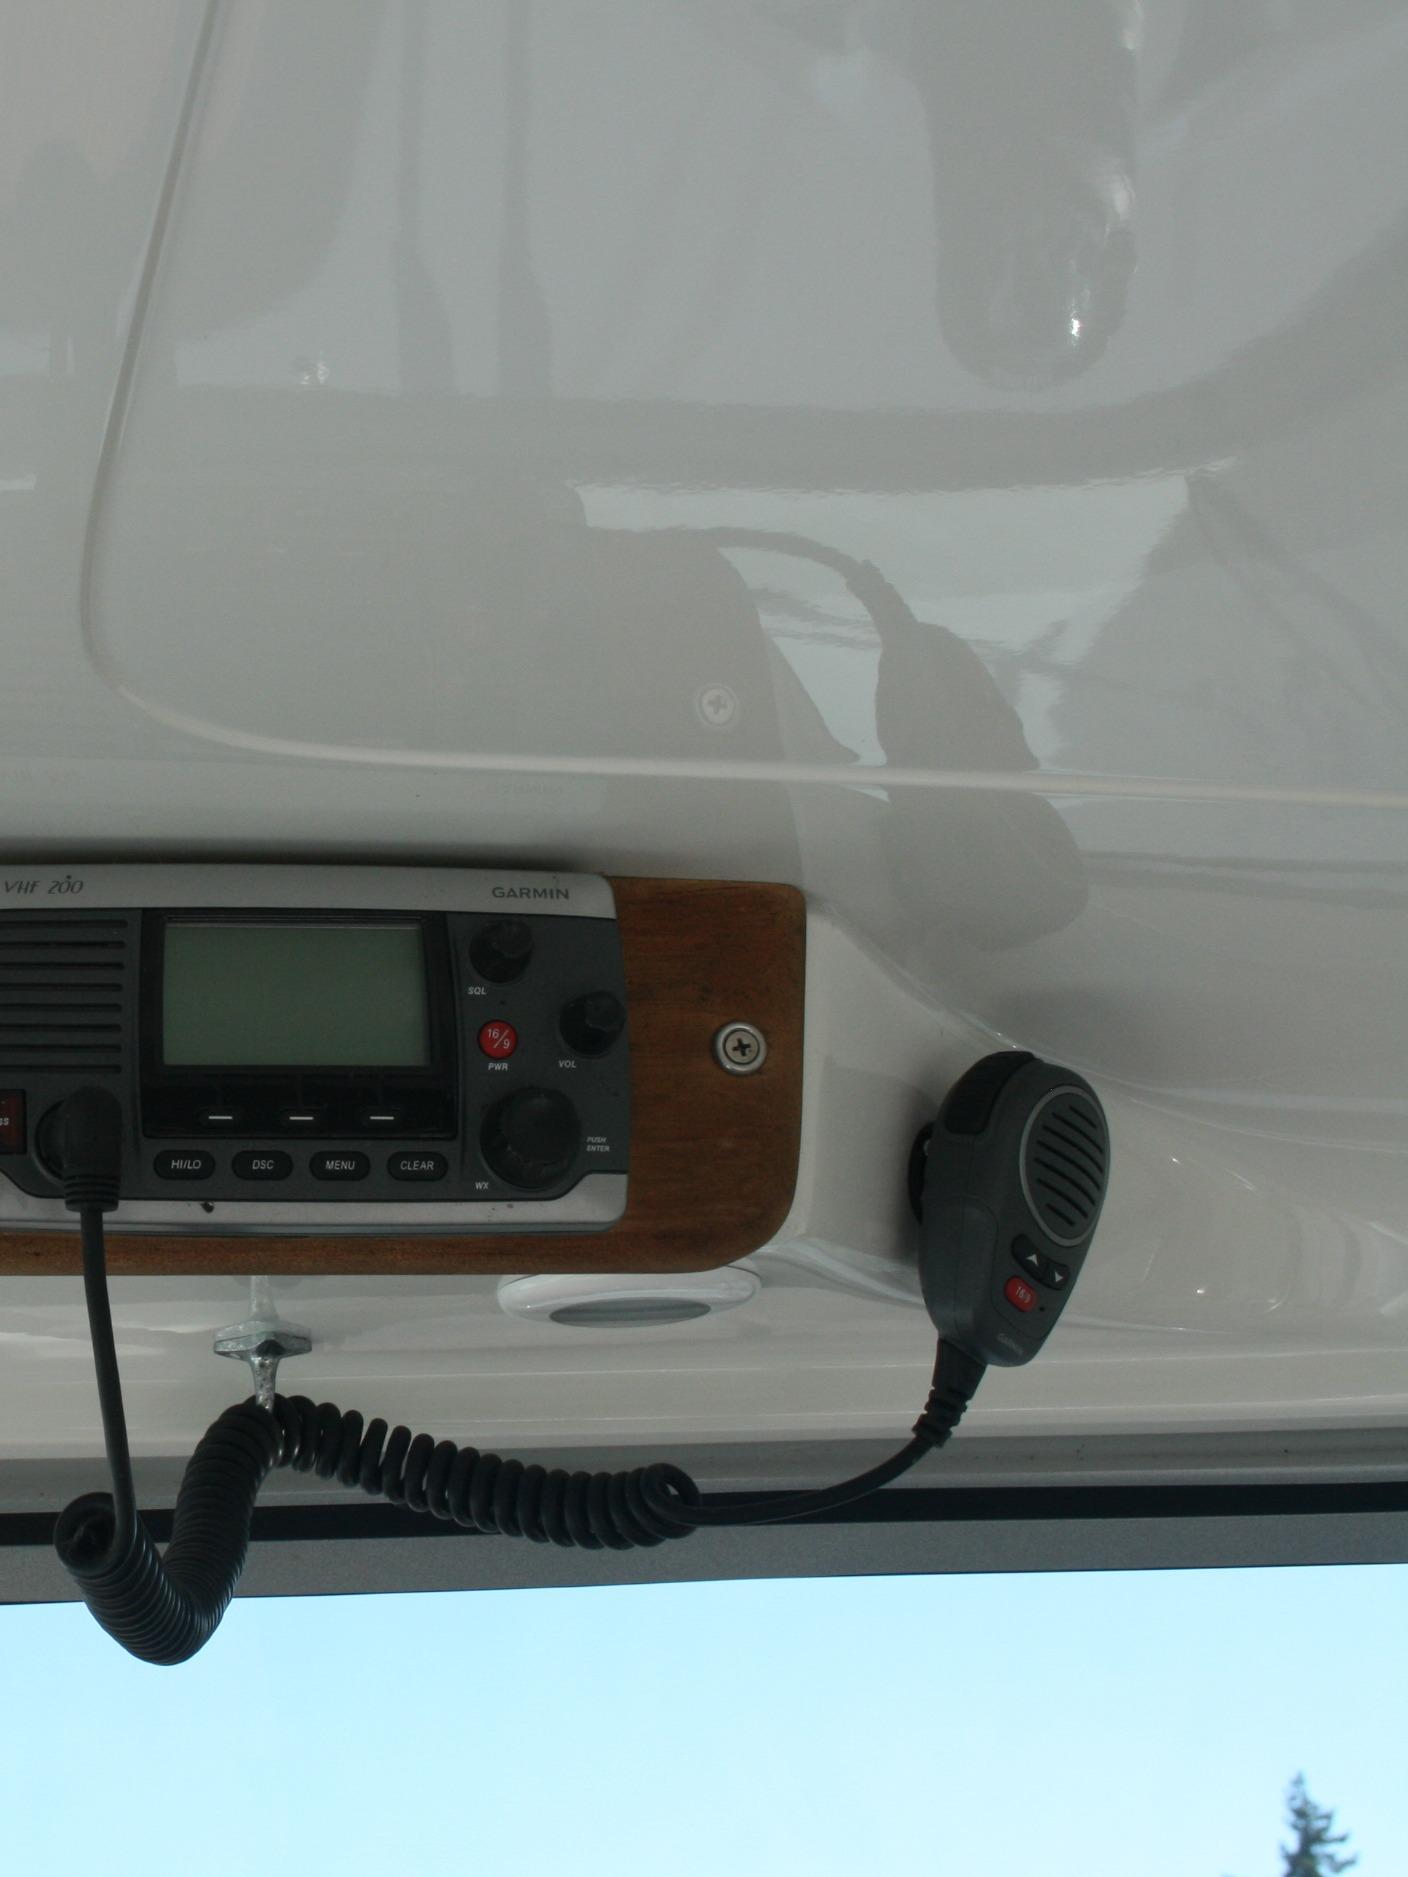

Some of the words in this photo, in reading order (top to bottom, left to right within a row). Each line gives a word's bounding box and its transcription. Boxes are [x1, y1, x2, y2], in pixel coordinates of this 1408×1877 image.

[4, 880, 40, 894] VHF
[48, 880, 84, 895] 200
[491, 886, 569, 900] GARMIN
[467, 986, 487, 996] SQL
[487, 1062, 509, 1071] PWR
[558, 1060, 577, 1069] VOL
[171, 1159, 202, 1170] HI/LO
[252, 1159, 274, 1170] DSC
[325, 1160, 356, 1171] MENU
[400, 1160, 435, 1171] CLEAR
[475, 1182, 489, 1190] WX
